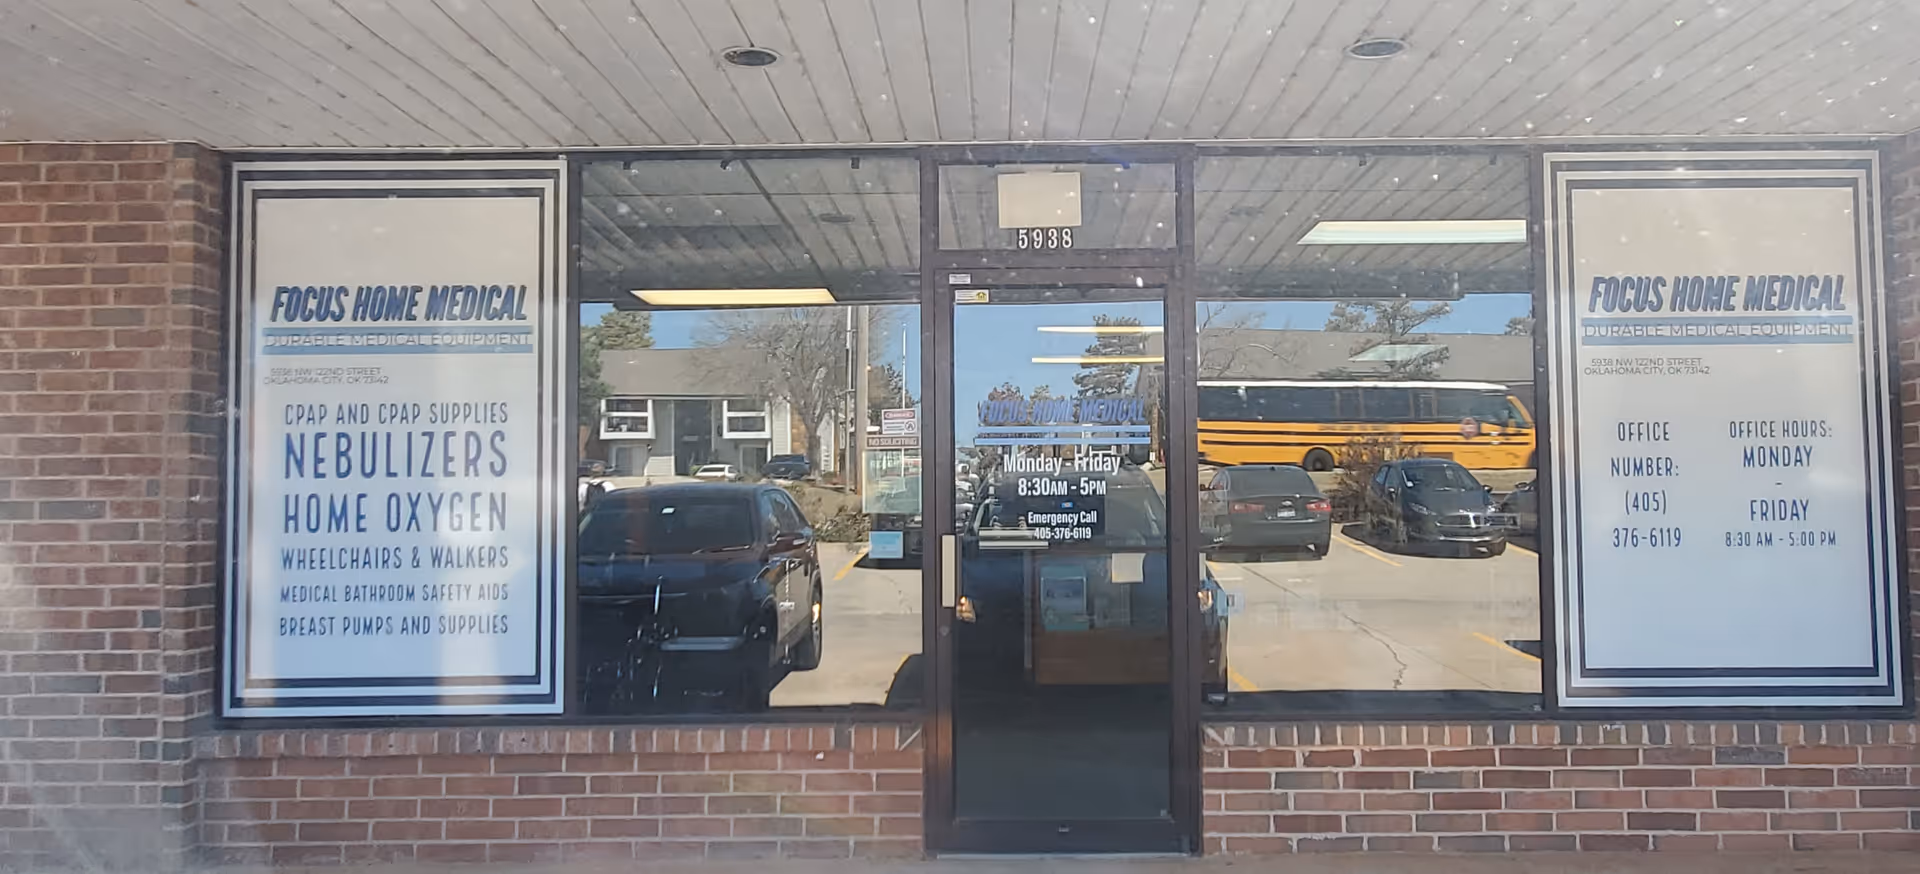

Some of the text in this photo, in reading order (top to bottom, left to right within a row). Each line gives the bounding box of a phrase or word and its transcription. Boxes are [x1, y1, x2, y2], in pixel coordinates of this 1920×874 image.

[1018, 228, 1073, 249] 5938
[270, 284, 528, 322] FOCUS HOME MEDICAL
[1588, 274, 1846, 312] FOCUS HOME MEDICAL
[264, 332, 529, 347] DURABLE MEDICAL EQUIPMENT
[1584, 322, 1852, 337] DURABLE MEDICAL EQUIPMENT
[346, 367, 382, 376] STREET
[1584, 365, 1710, 376] OKLAHOMA CITY, OK 73142
[1591, 357, 1703, 367] 5938 NW 122ND STREET
[285, 401, 508, 425] CPAP AND CPAP SUPPLIES
[977, 399, 1146, 423] FOCUS HOME MEDICAL
[1617, 421, 1670, 442] OFFICE
[1729, 419, 1833, 438] OFFICE HOURS:
[284, 430, 508, 479] NEBULIZERS
[1003, 453, 1062, 476] Monday
[1074, 454, 1121, 476] Friday
[1743, 445, 1813, 468] MONDAY
[1611, 457, 1680, 477] NUMBER:
[1017, 477, 1068, 496] 8:30AM
[1079, 477, 1107, 495] 5PM
[284, 491, 507, 533] HOME OXYGEN
[1625, 489, 1667, 515] (405)
[1750, 499, 1810, 521] FRIDAY
[1027, 511, 1098, 526] Emergency Call
[1034, 527, 1092, 539] 405-376-6119
[1612, 527, 1681, 547] 376-6119
[1725, 531, 1751, 546] 8:30
[1756, 531, 1773, 546] AM
[1788, 530, 1815, 546] 5:00
[1820, 530, 1837, 546] PM
[281, 546, 509, 571] WHEELCHAIRS & WALKERS
[280, 583, 509, 603] MEDICAL BATHROOM SAFETY AIDS
[280, 614, 509, 636] BREAST PUMPS AND SUPPLIES
